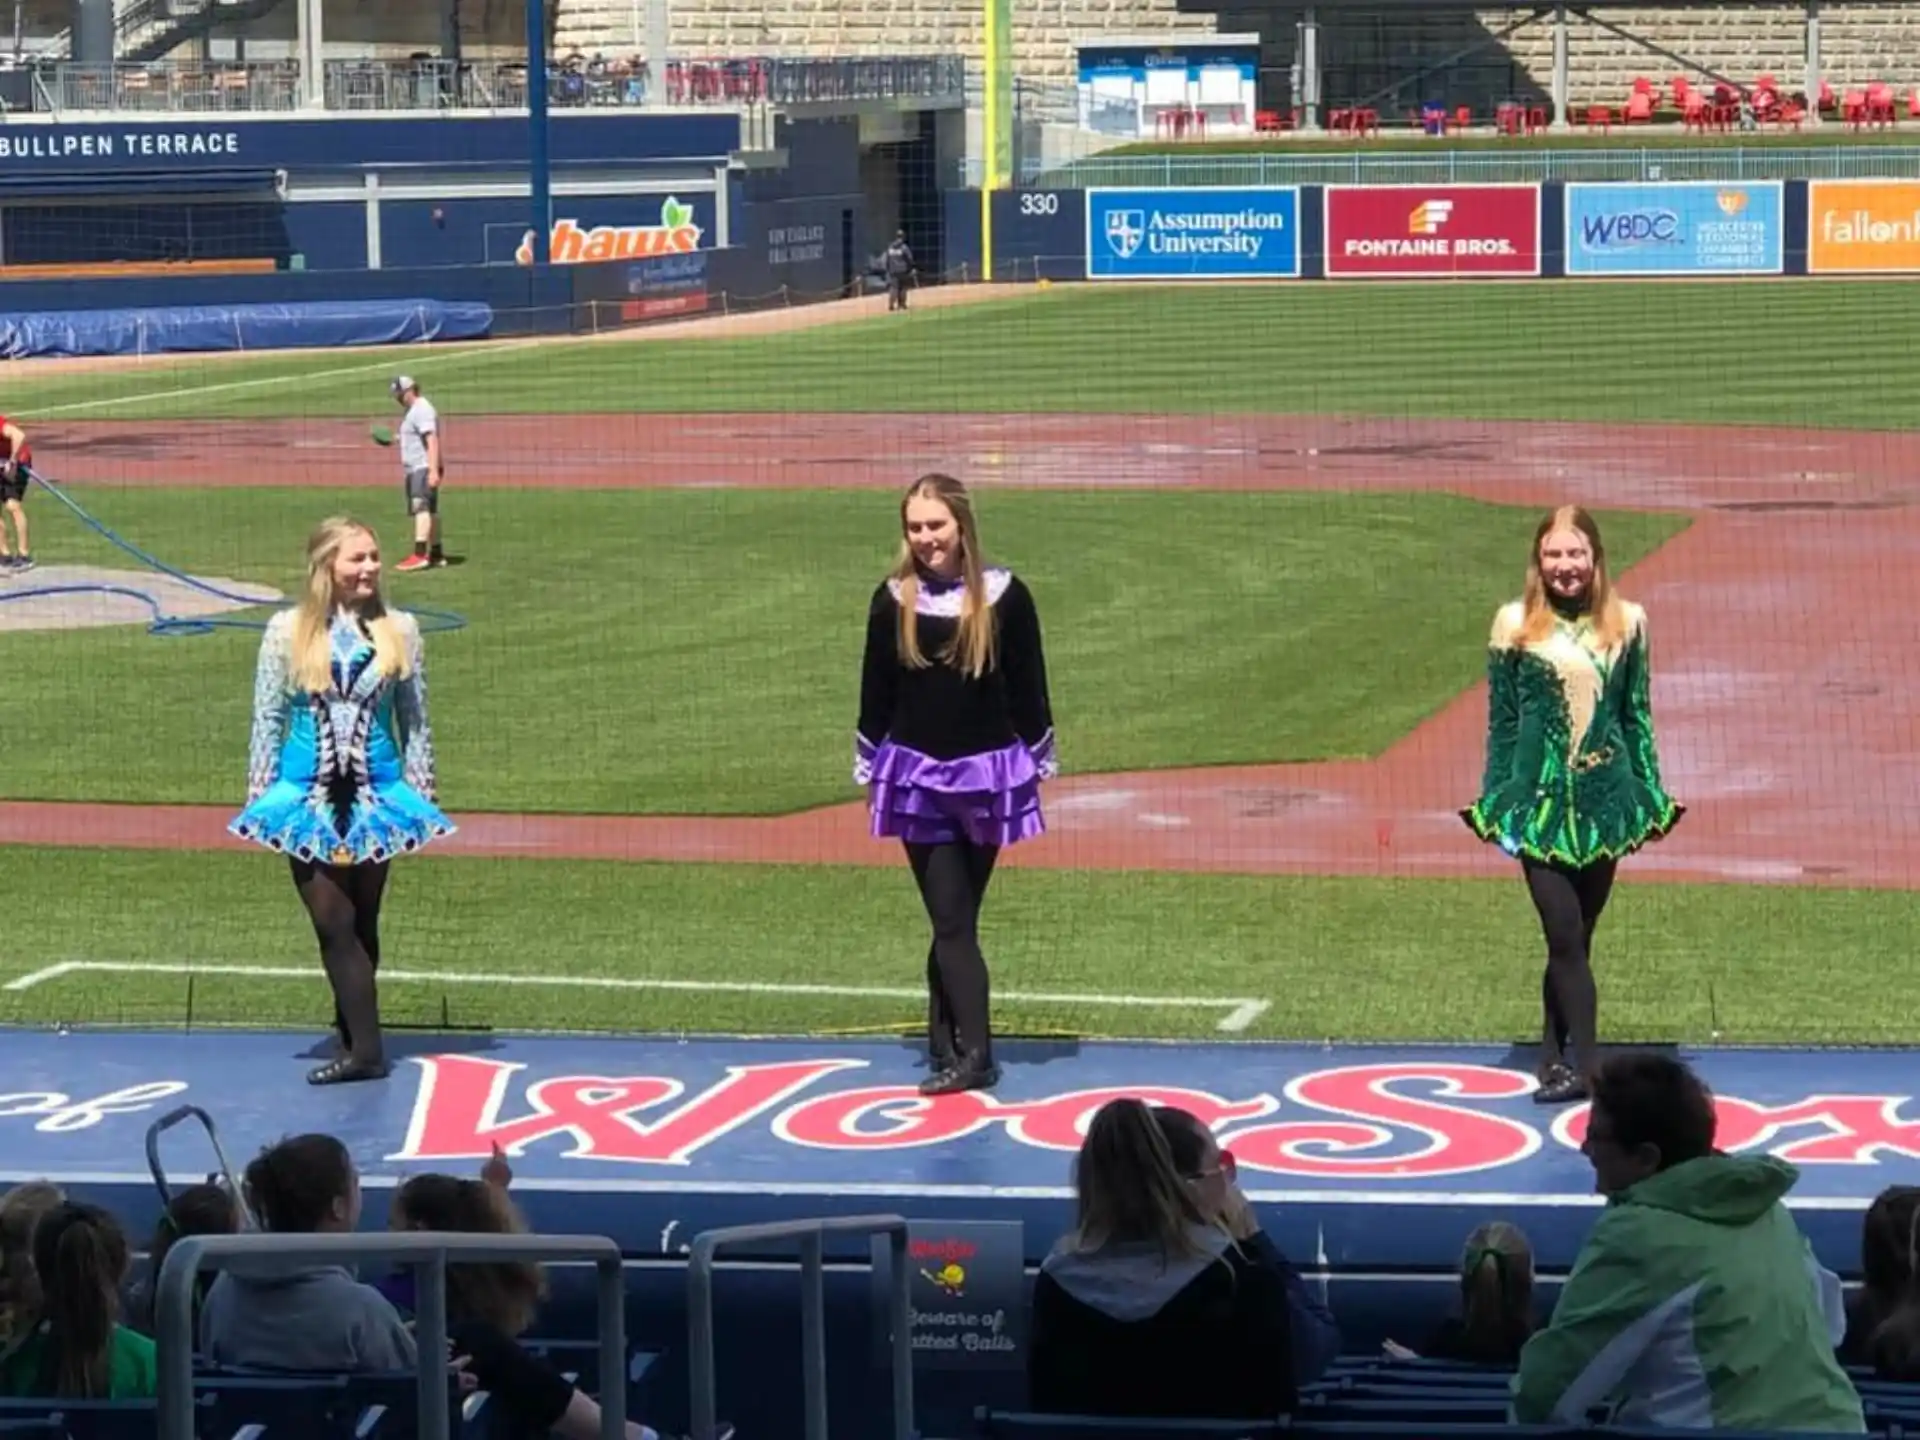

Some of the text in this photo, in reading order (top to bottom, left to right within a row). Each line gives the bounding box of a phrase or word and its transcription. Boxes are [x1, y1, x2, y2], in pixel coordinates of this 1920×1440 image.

[0, 133, 240, 157] BULLPEN TERRACE
[1020, 194, 1058, 215] 330
[1149, 209, 1284, 233] Assumption
[1583, 213, 1678, 245] WBDC
[515, 218, 702, 264] haws
[1149, 232, 1263, 257] University
[1345, 239, 1518, 256] FONTAINE BROS.
[981, 1309, 1005, 1333] of
[961, 1331, 1016, 1351] Balls
